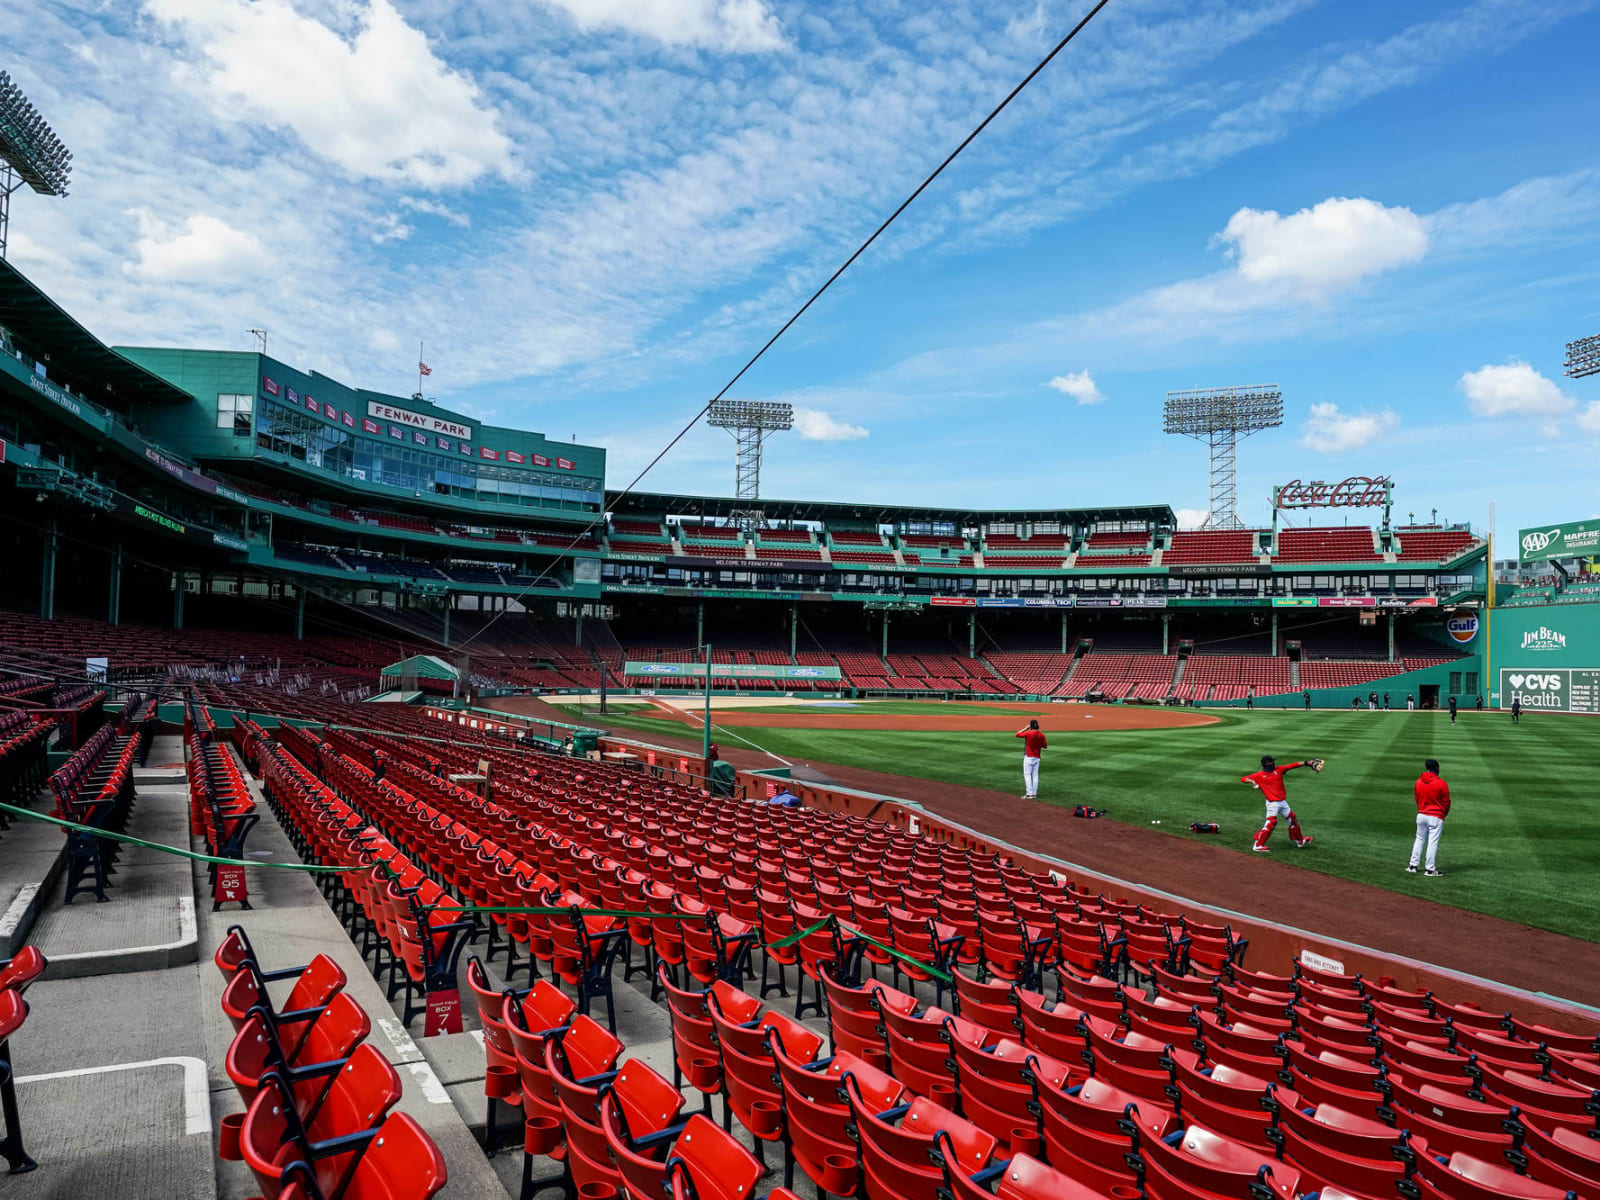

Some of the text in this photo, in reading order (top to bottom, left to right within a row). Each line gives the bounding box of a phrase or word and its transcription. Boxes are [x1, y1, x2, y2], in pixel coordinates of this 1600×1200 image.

[375, 405, 466, 437] FENWAY PARK
[1277, 475, 1391, 509] Coca-Cola
[1522, 532, 1549, 551] AAA
[1563, 530, 1600, 541] MAPFRE
[1449, 619, 1477, 631] Gulf
[1521, 626, 1567, 648] JIM BEAM
[1535, 640, 1554, 648] 225
[1525, 674, 1562, 691] CVS
[1511, 690, 1562, 707] Health
[221, 880, 240, 888] 95
[435, 1005, 452, 1013] BOX
[439, 1013, 449, 1025] 7
